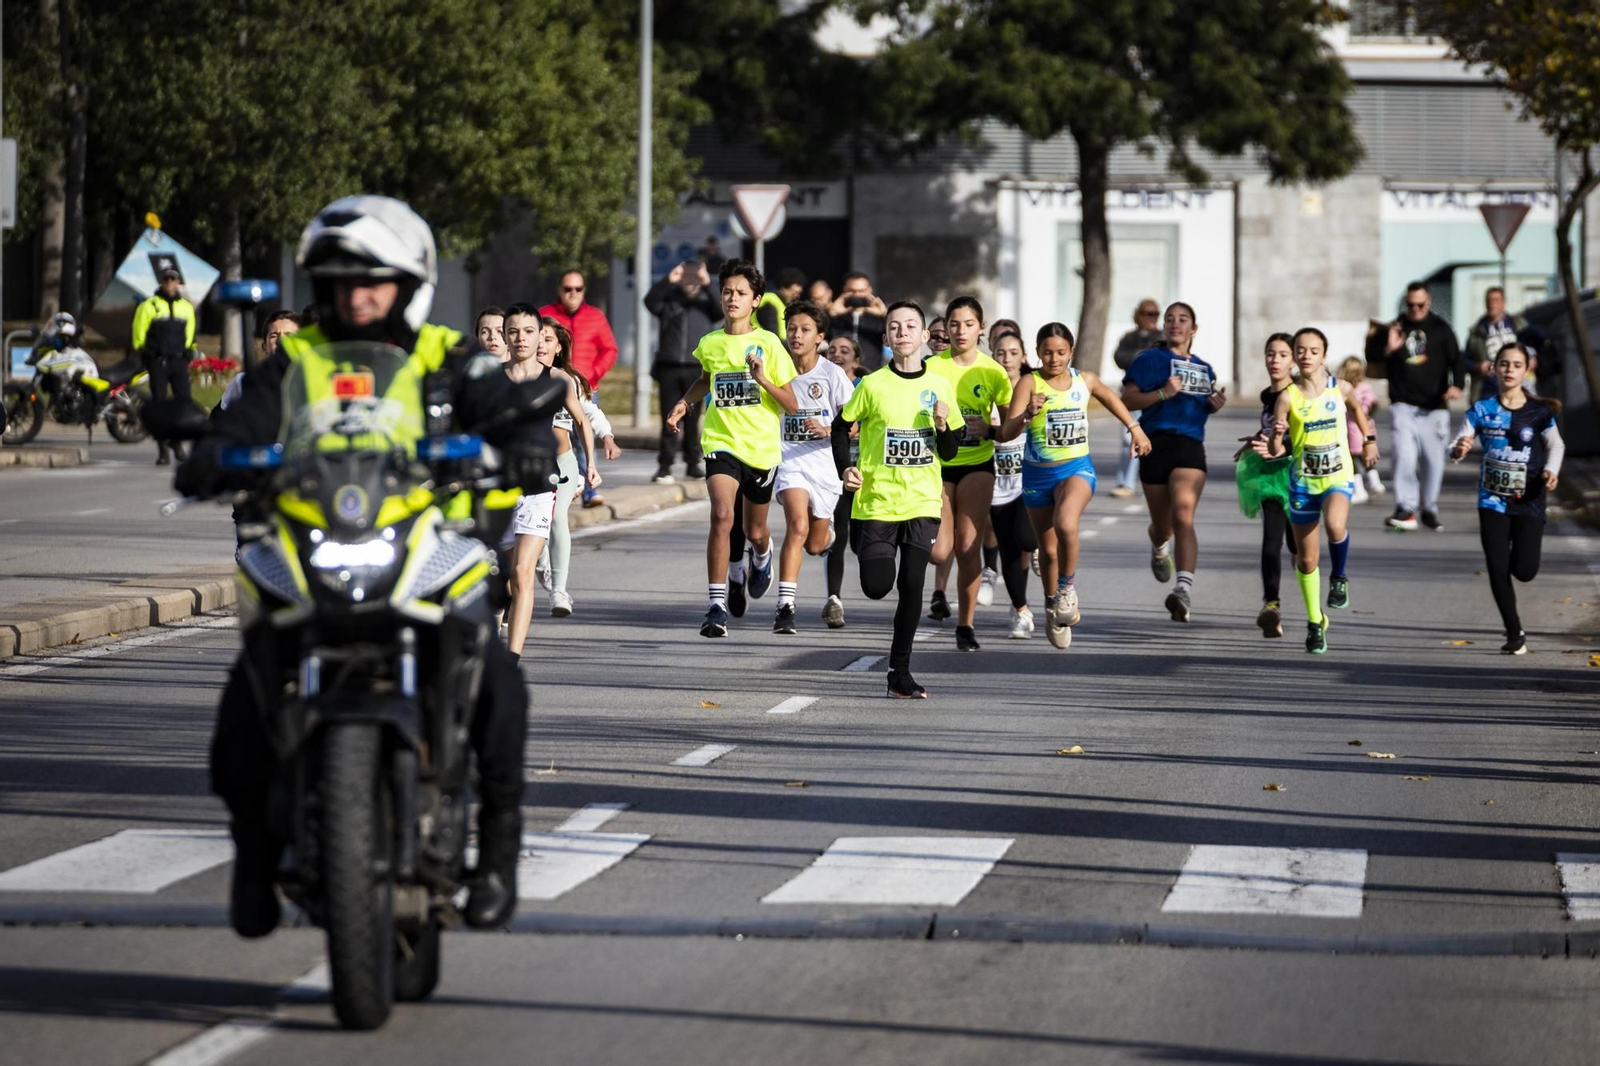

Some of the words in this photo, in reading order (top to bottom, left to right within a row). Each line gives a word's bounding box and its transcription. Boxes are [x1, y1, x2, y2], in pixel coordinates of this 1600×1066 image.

[1176, 369, 1197, 385] 576
[716, 382, 745, 399] 584
[785, 418, 808, 433] 585
[1052, 423, 1075, 439] 577
[888, 440, 921, 457] 590
[997, 453, 1022, 468] 583
[1306, 454, 1330, 468] 574
[1484, 468, 1511, 486] 568
